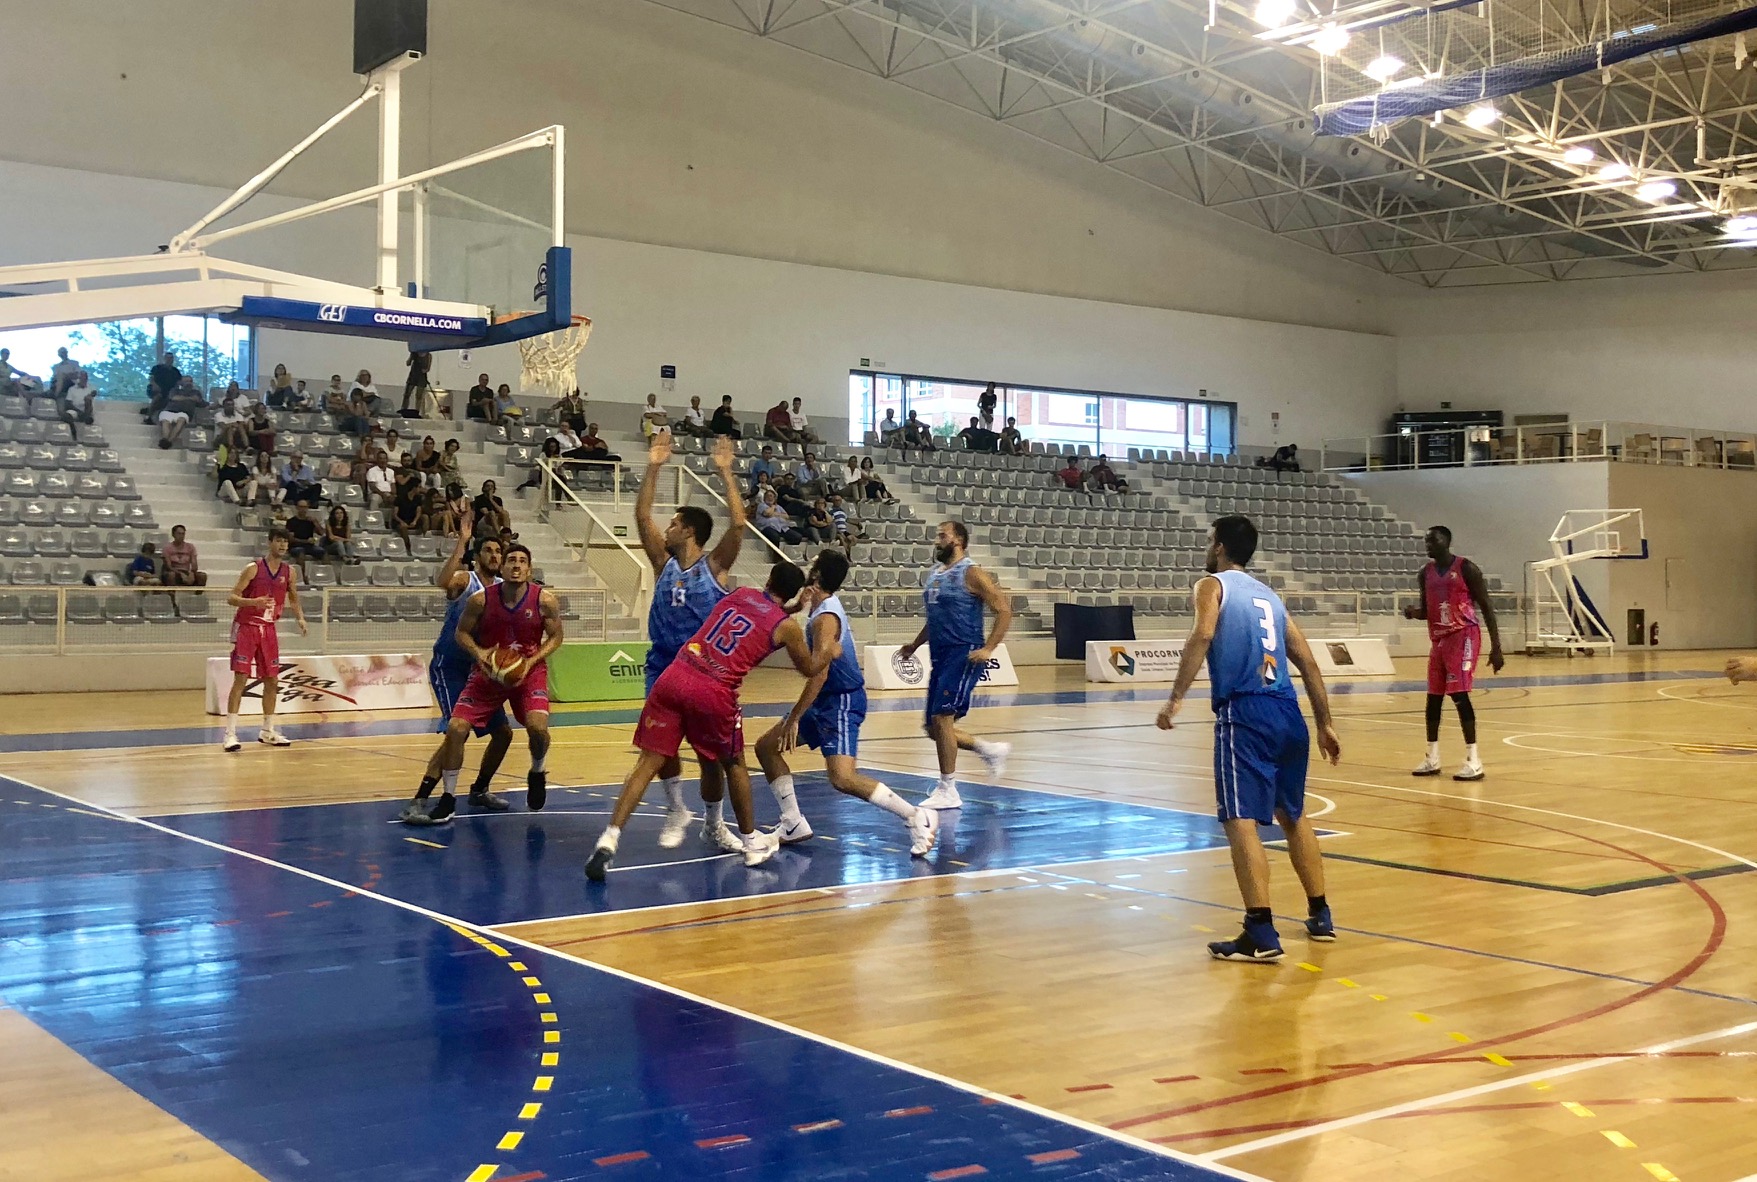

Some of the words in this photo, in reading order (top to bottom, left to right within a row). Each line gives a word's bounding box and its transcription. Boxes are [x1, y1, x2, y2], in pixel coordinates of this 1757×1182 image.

[318, 303, 347, 321] GES
[374, 312, 461, 330] CBCORNELLA.COM
[705, 607, 754, 656] 13
[1252, 597, 1276, 651] 3
